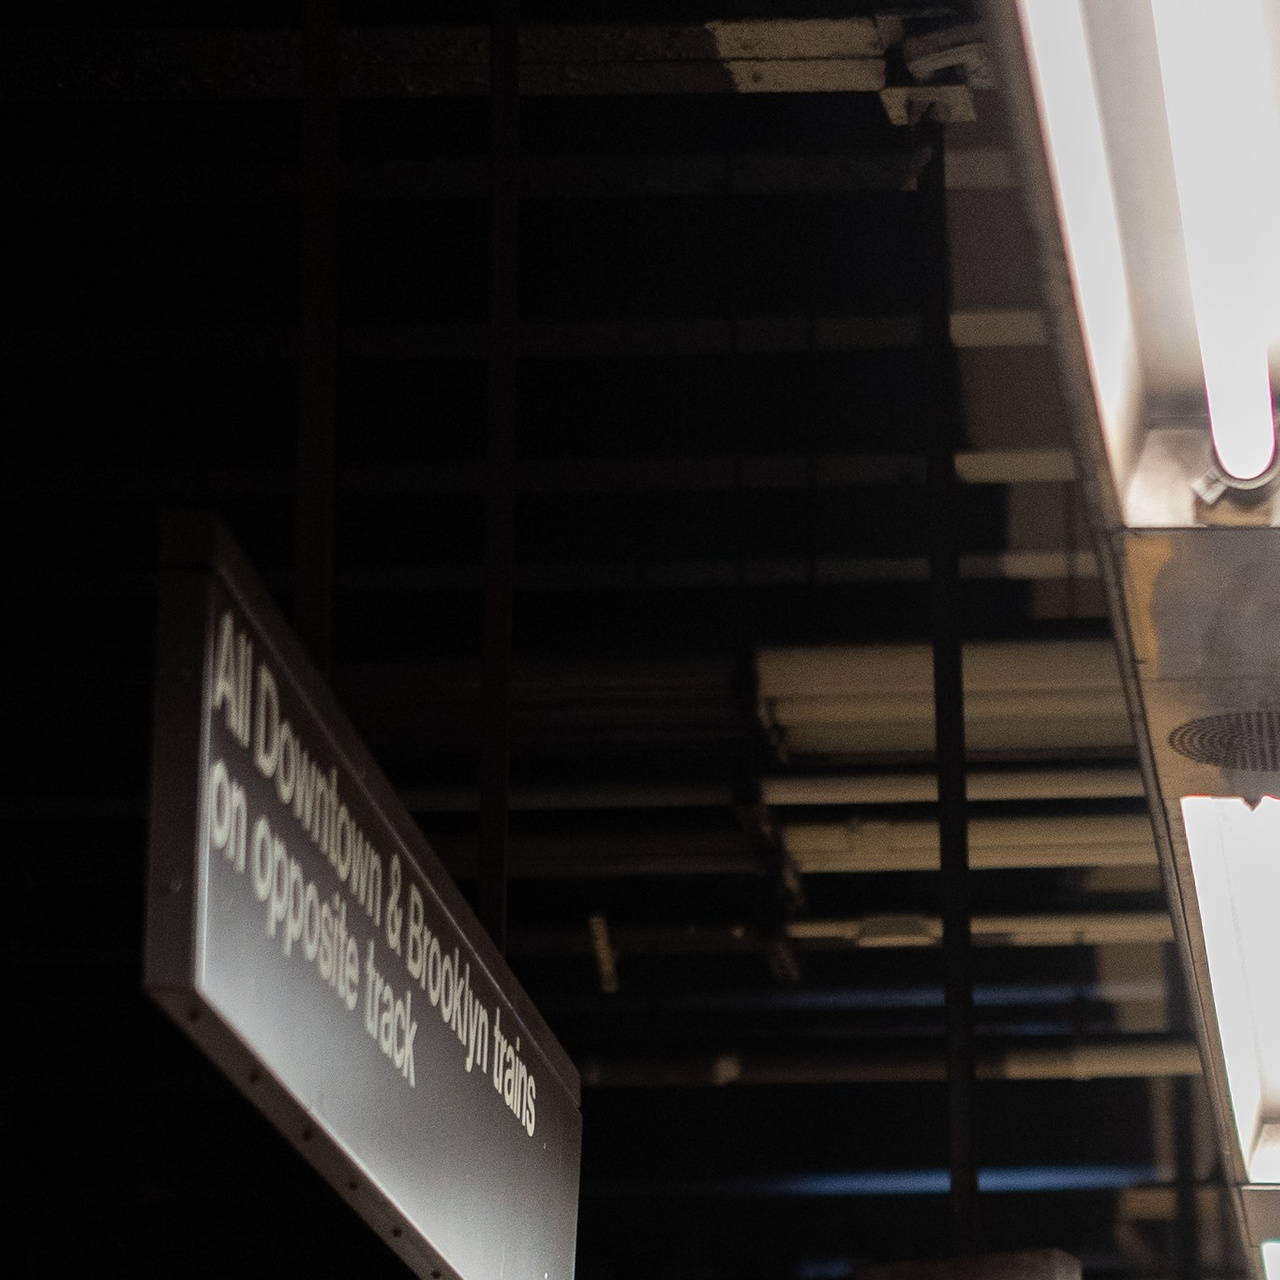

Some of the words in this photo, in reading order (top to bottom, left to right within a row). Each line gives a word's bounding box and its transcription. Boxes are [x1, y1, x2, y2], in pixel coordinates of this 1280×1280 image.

[211, 760, 247, 873] on
[251, 818, 360, 1012] opposite
[365, 940, 418, 1088] track
[213, 612, 252, 748] All
[254, 664, 382, 926] Downtown
[385, 854, 401, 955] &
[407, 885, 489, 1073] Brooklyn
[493, 1006, 536, 1138] trains
